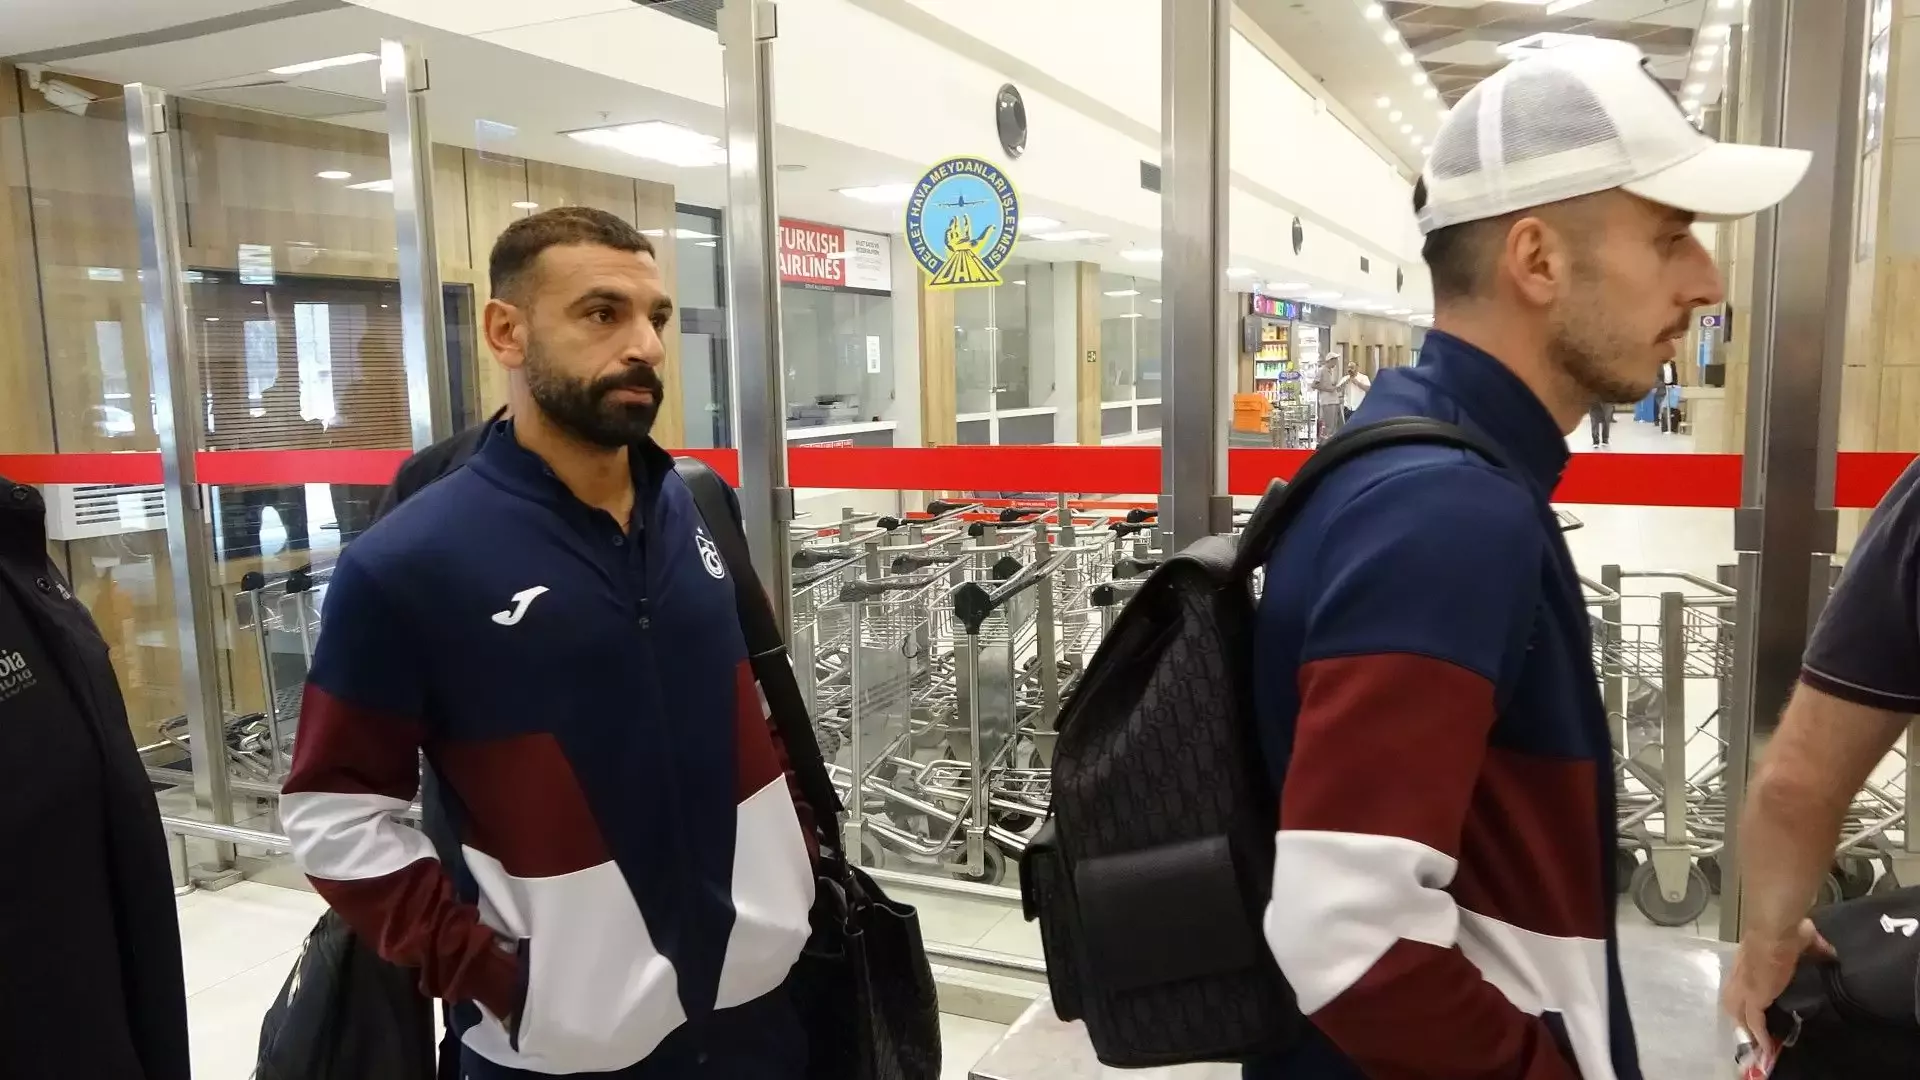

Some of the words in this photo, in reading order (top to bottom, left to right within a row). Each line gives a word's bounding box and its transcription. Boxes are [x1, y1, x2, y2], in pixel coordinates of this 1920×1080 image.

[930, 161, 1006, 193] MEYDANLARI
[911, 183, 932, 217] HAVA
[779, 227, 838, 255] TURKISH
[910, 221, 939, 270] DEVLET
[779, 253, 841, 281] AIRLINES
